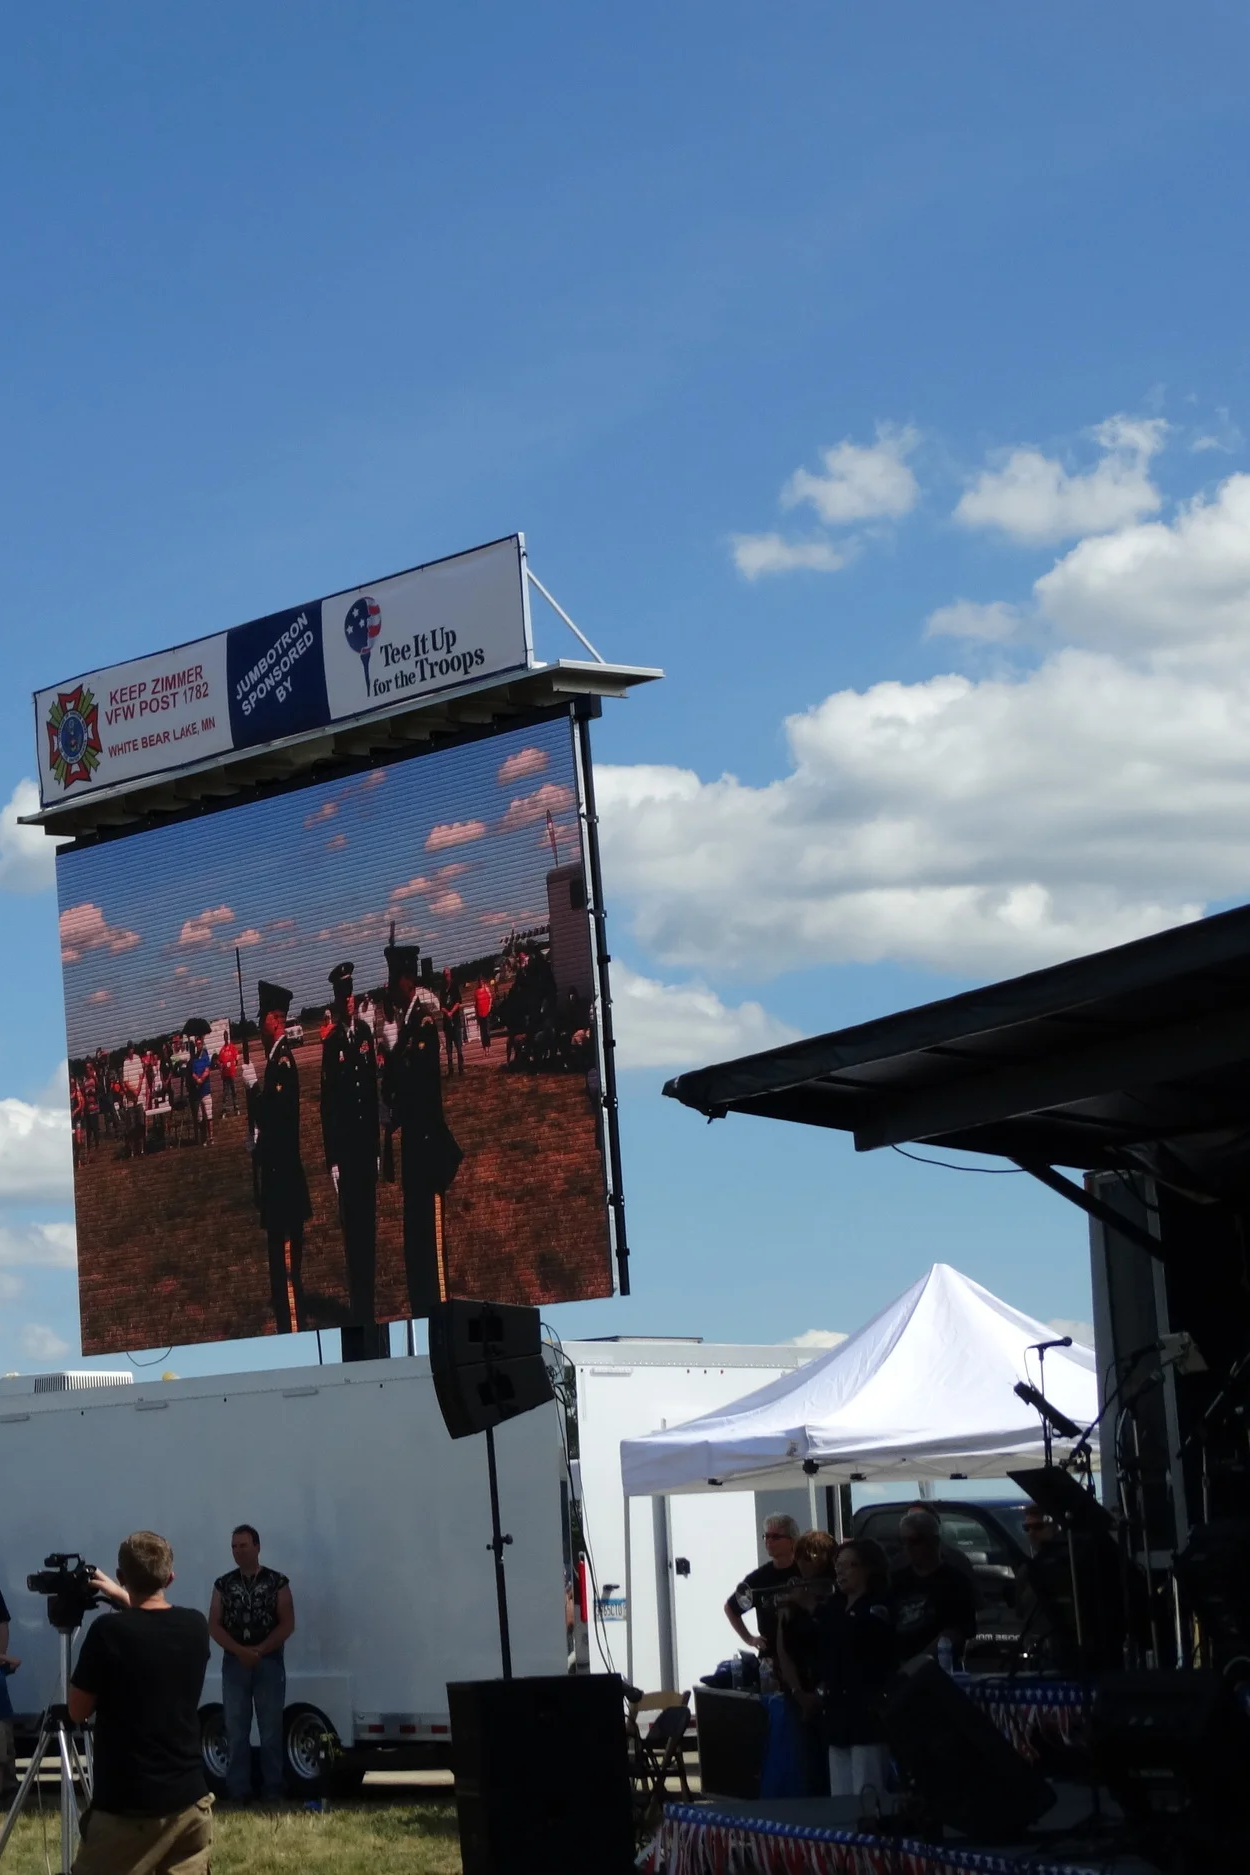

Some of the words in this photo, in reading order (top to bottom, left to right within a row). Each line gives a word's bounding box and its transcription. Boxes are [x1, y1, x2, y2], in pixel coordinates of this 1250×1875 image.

[235, 612, 309, 700] JUMBOTRON
[379, 642, 411, 667] Tee
[412, 633, 430, 658] It
[430, 627, 457, 655] Up
[109, 682, 147, 707] KEEP
[151, 664, 203, 696] ZIMMER
[241, 630, 314, 716] SPONSORED
[275, 676, 293, 703] BY
[372, 678, 392, 697] for
[394, 670, 416, 690] the
[415, 647, 485, 683] Troops
[105, 703, 136, 726] VFW
[139, 692, 179, 717] POST
[182, 682, 209, 704] 1782
[108, 739, 139, 758] WHITE
[141, 731, 171, 748] BEAR
[172, 722, 200, 741] LAKE,
[201, 716, 216, 732] MN
